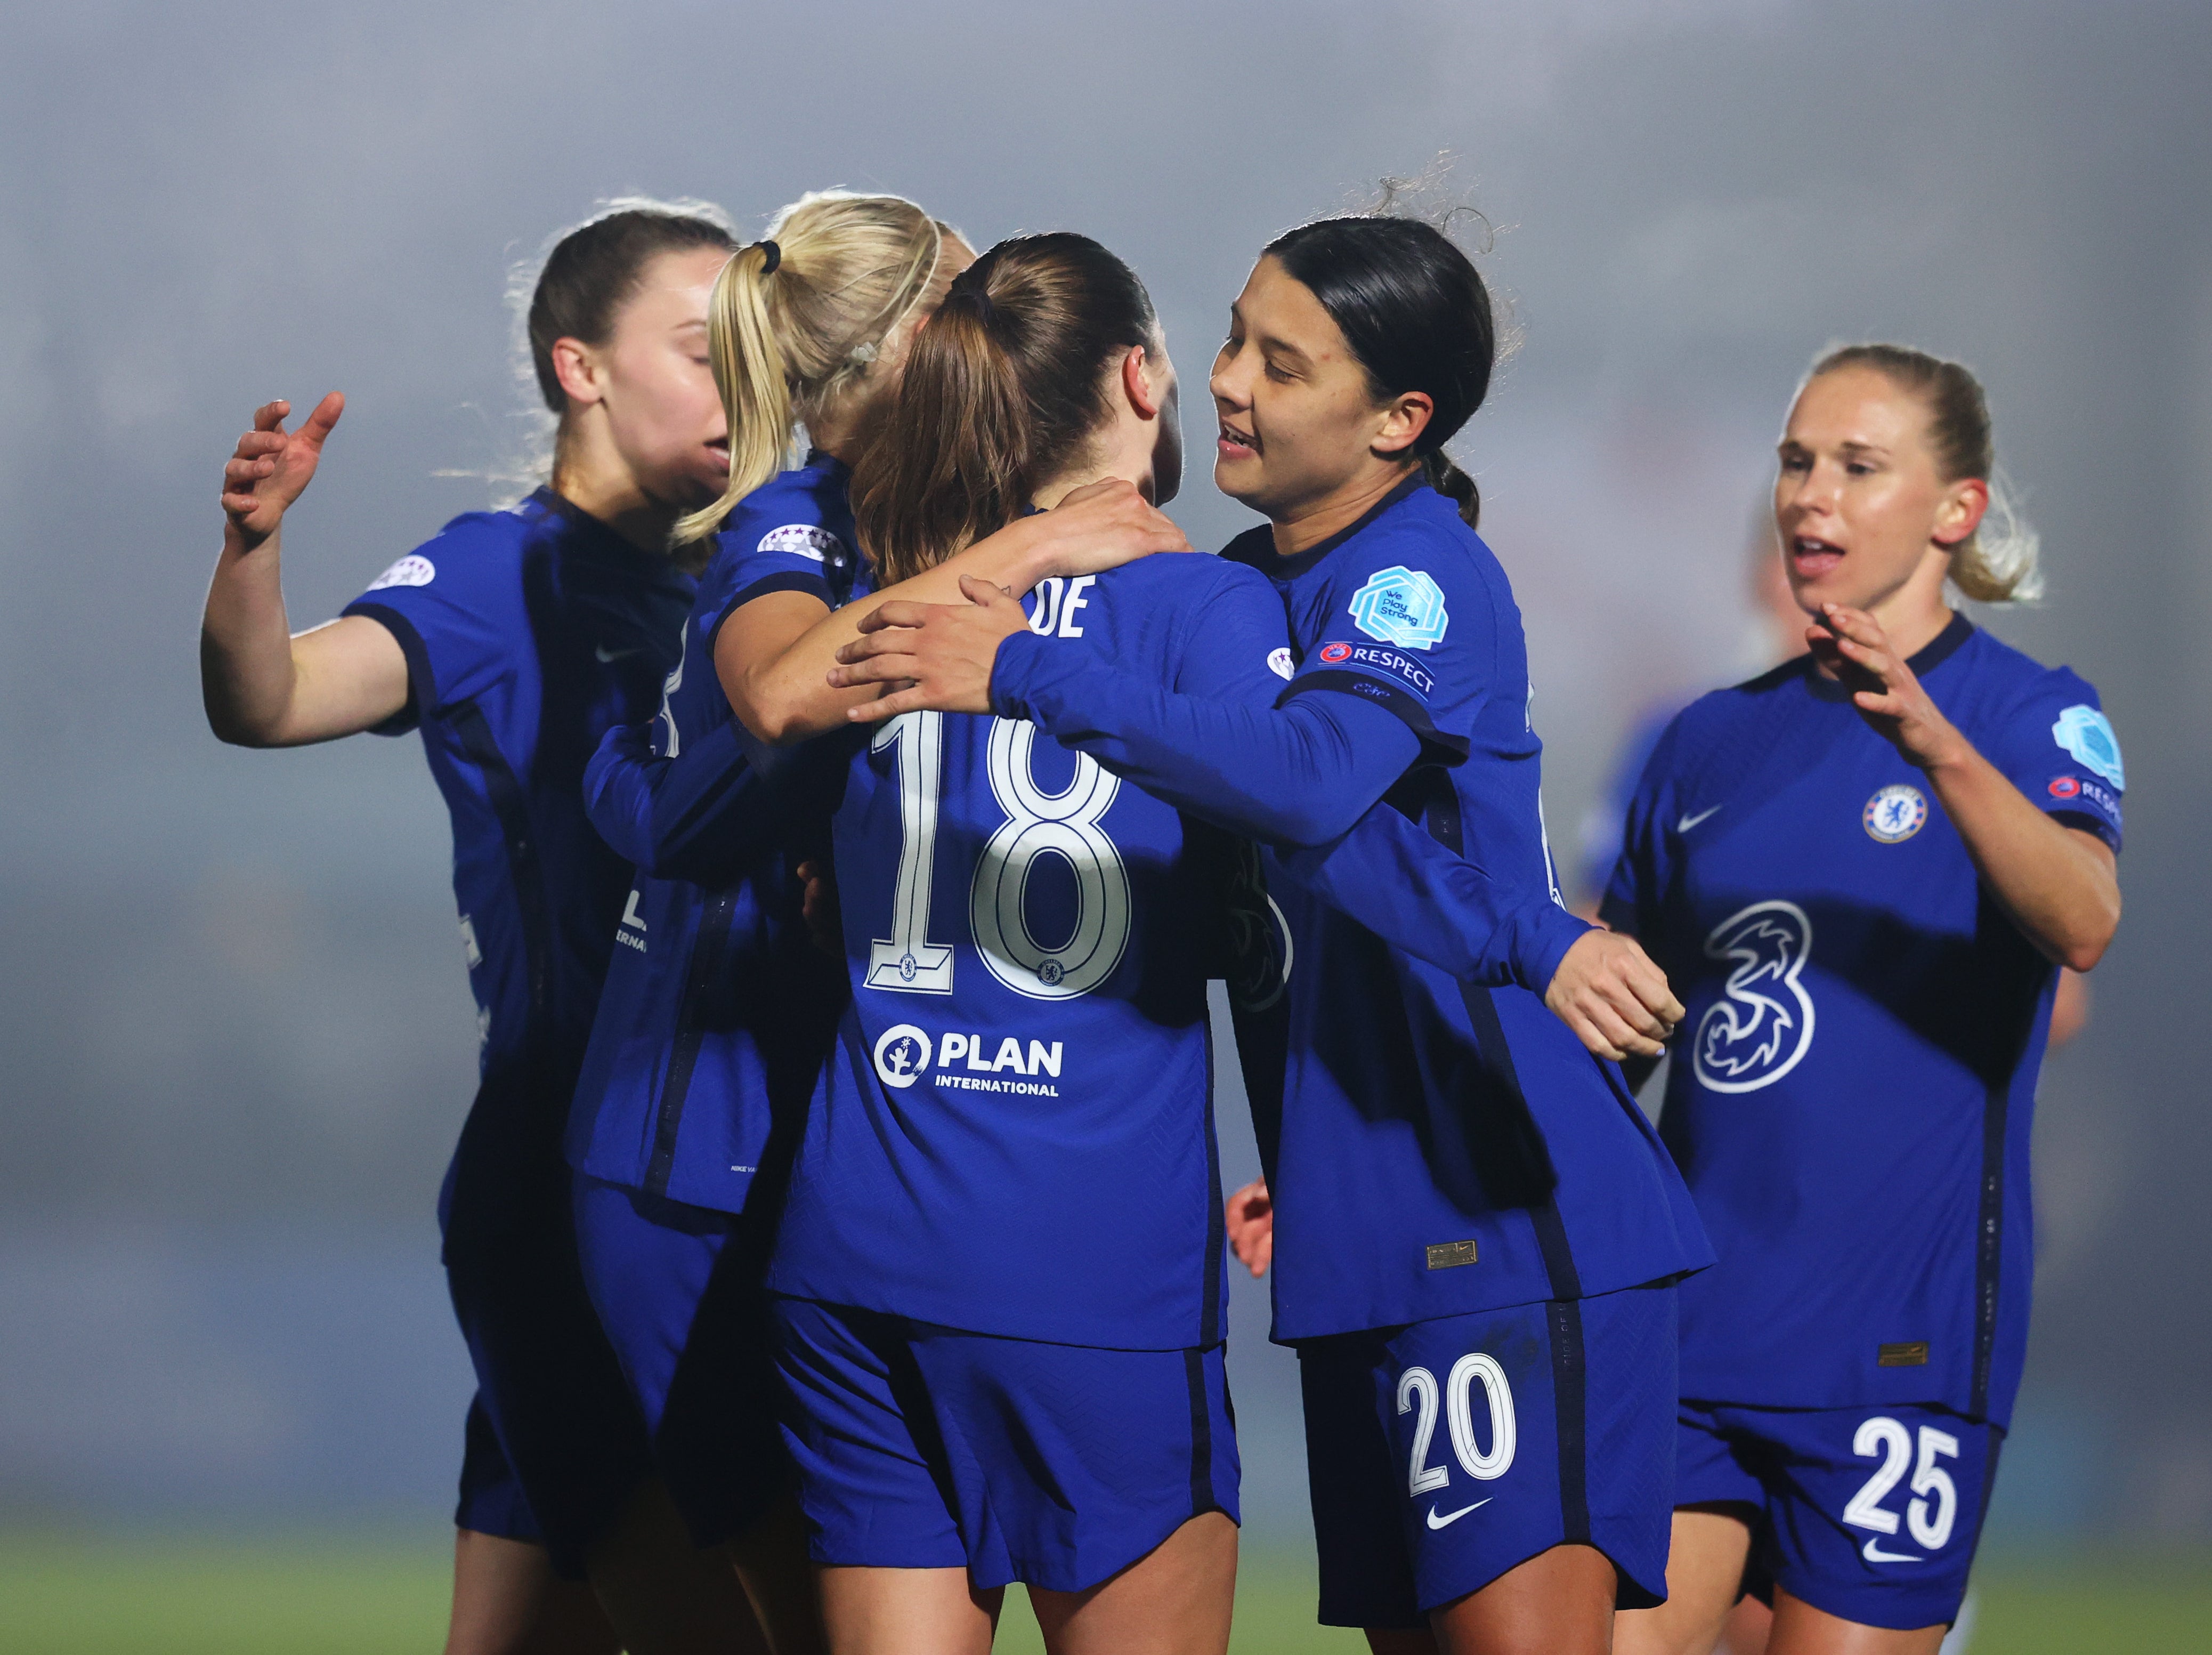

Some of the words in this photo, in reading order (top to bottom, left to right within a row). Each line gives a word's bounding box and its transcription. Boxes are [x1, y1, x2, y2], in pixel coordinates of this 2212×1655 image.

[1027, 574, 1096, 638] DE
[1380, 607, 1419, 627] Strong
[1385, 590, 1403, 600] We
[1354, 648, 1435, 692] RESPECT
[862, 710, 1132, 1002] 18
[937, 1032, 1064, 1078] PLAN
[935, 1074, 1059, 1098] INTERNATIONAL
[1396, 1352, 1517, 1498] 20
[1842, 1415, 1961, 1551] 25
